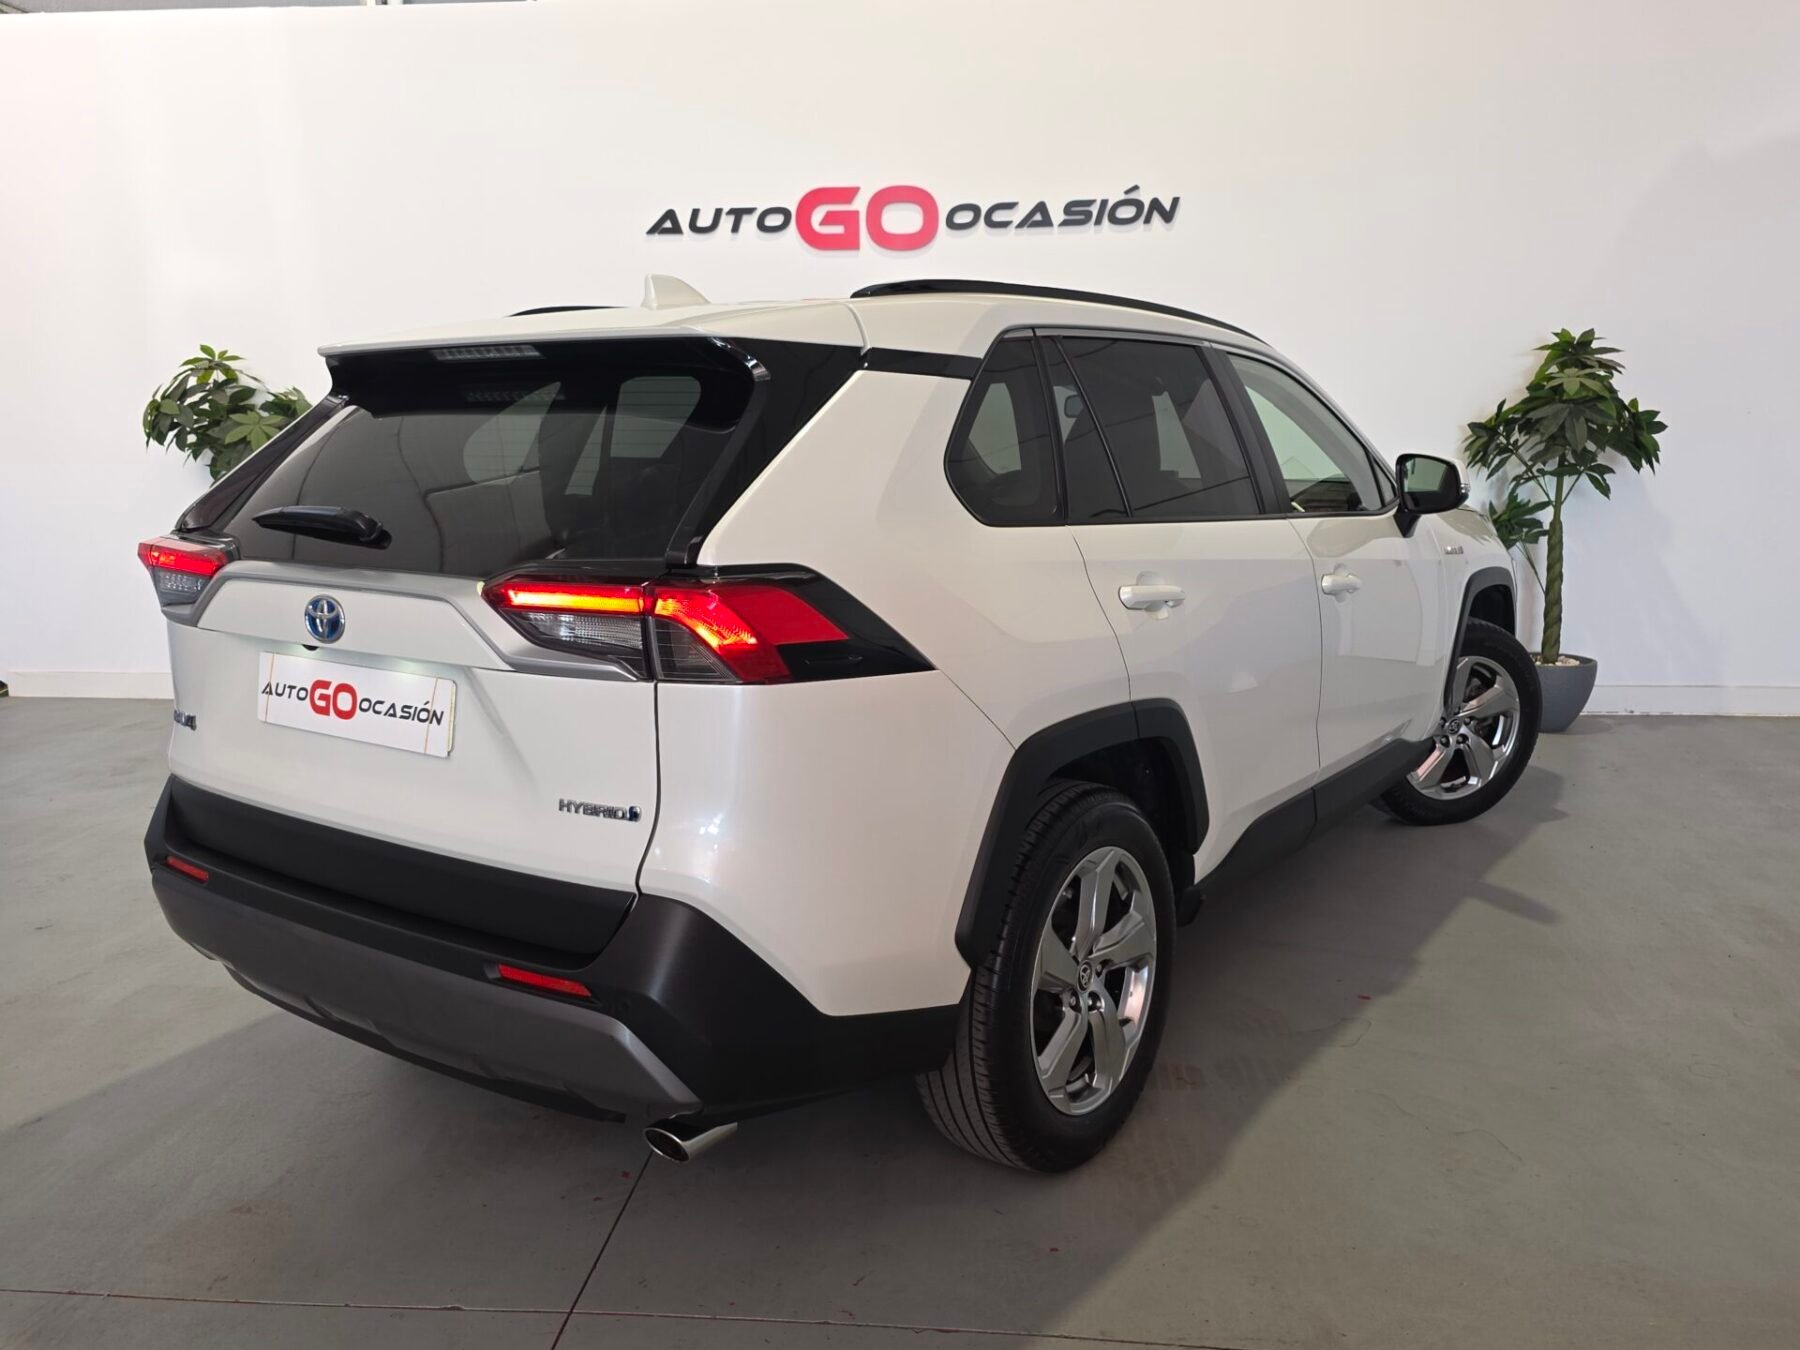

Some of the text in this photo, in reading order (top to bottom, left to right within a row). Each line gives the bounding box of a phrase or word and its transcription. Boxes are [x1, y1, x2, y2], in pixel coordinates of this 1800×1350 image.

[646, 184, 1181, 251] AUTO GO OCASIÓN
[261, 679, 444, 726] AUTO GO OCASIÓN
[558, 798, 627, 820] HYBRID
